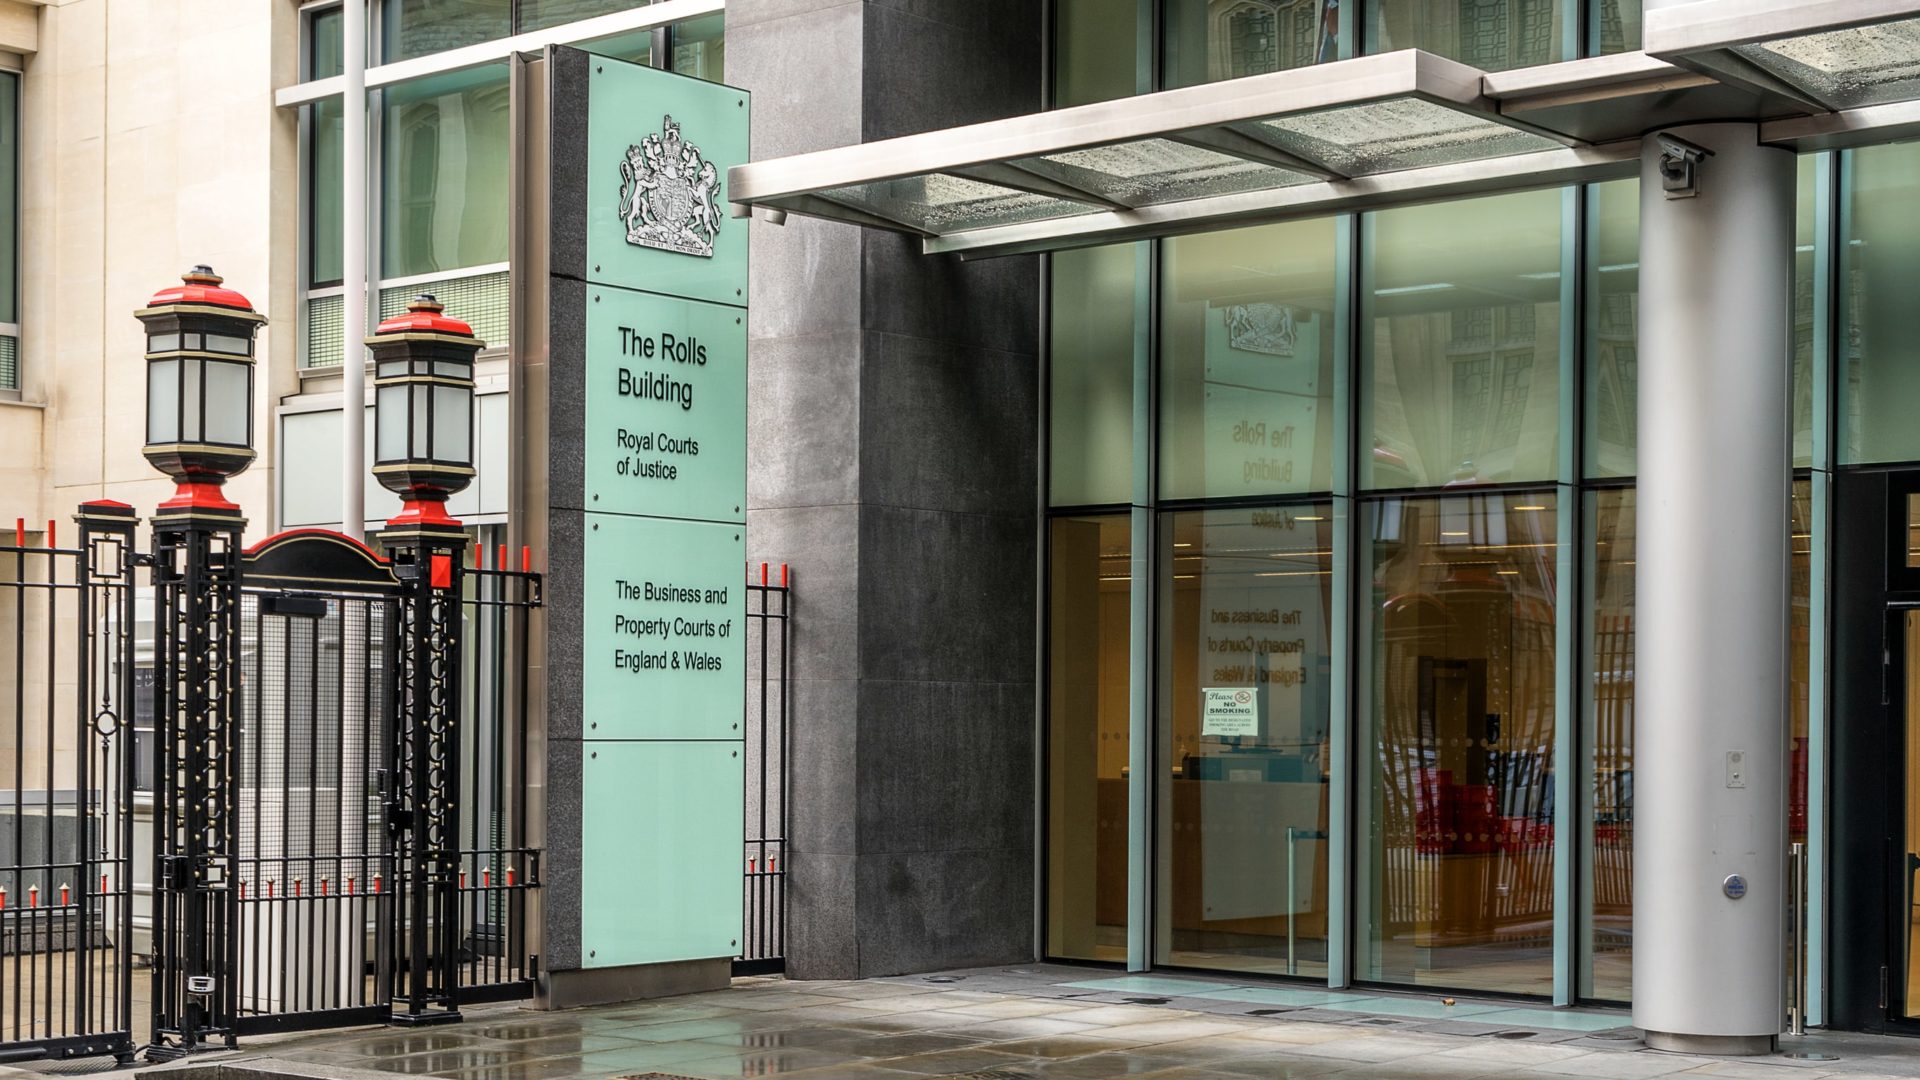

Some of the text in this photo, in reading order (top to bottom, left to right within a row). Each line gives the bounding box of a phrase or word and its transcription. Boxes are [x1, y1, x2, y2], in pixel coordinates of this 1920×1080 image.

[618, 326, 707, 365] The Rolls
[618, 367, 693, 410] Building
[617, 428, 699, 455] Royal Courts
[616, 456, 677, 480] of Justice
[615, 580, 728, 604] The Business and
[615, 614, 731, 640] Property Courts of
[615, 649, 722, 673] England & Wales
[1209, 691, 1233, 700] Please
